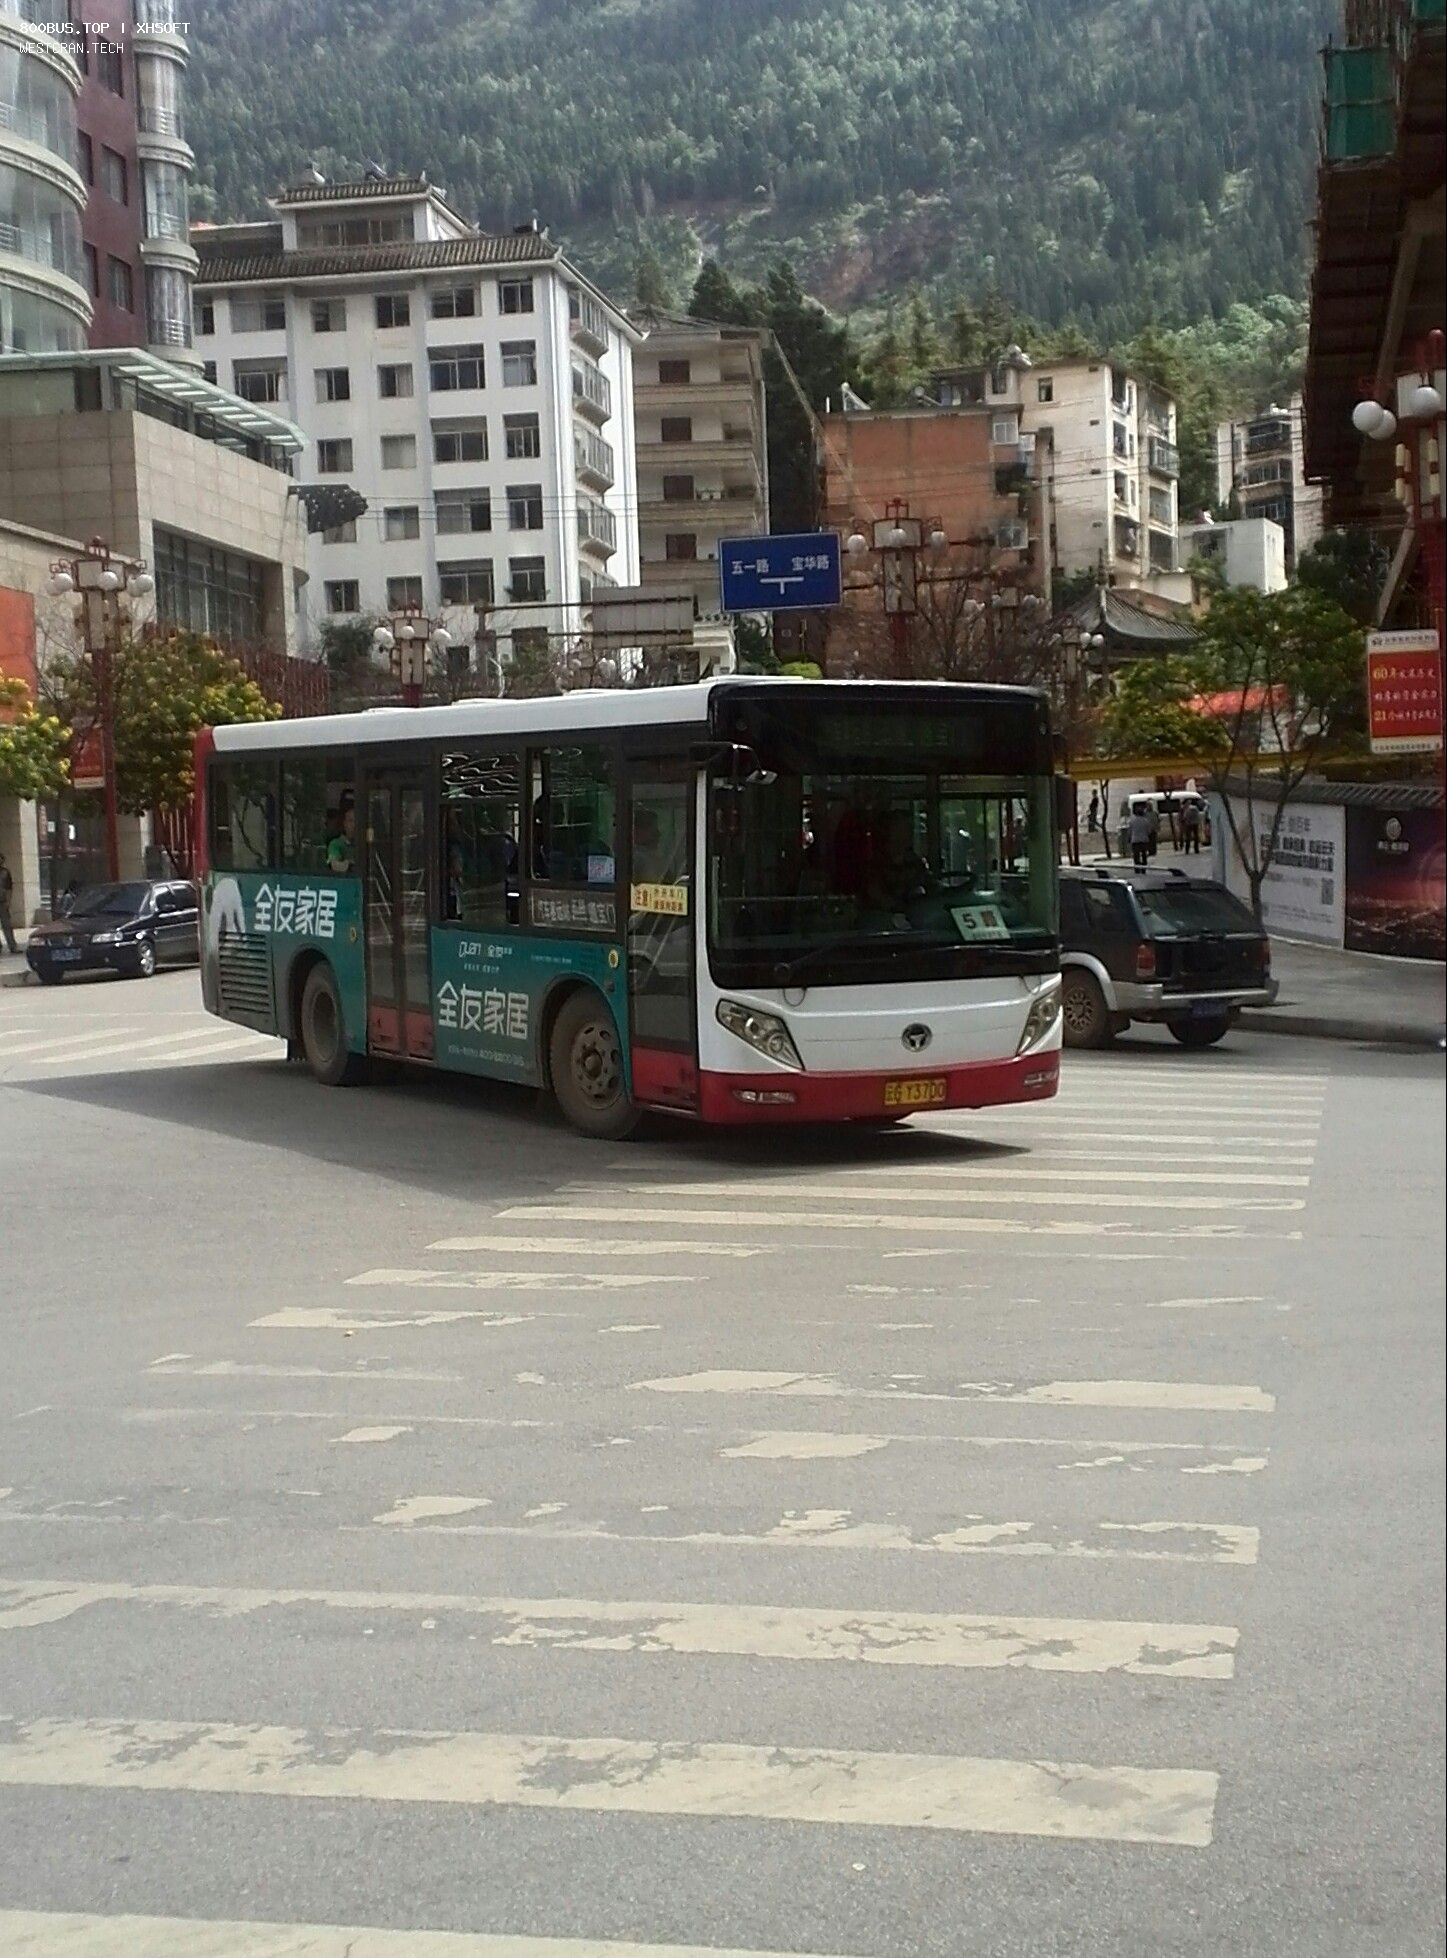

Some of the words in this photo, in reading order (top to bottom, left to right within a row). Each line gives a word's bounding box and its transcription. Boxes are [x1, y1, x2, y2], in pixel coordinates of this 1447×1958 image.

[731, 558, 769, 575] 五一路
[791, 554, 830, 571] 宝华路
[254, 882, 338, 938] 全友家居
[437, 980, 529, 1040] 全友家居
